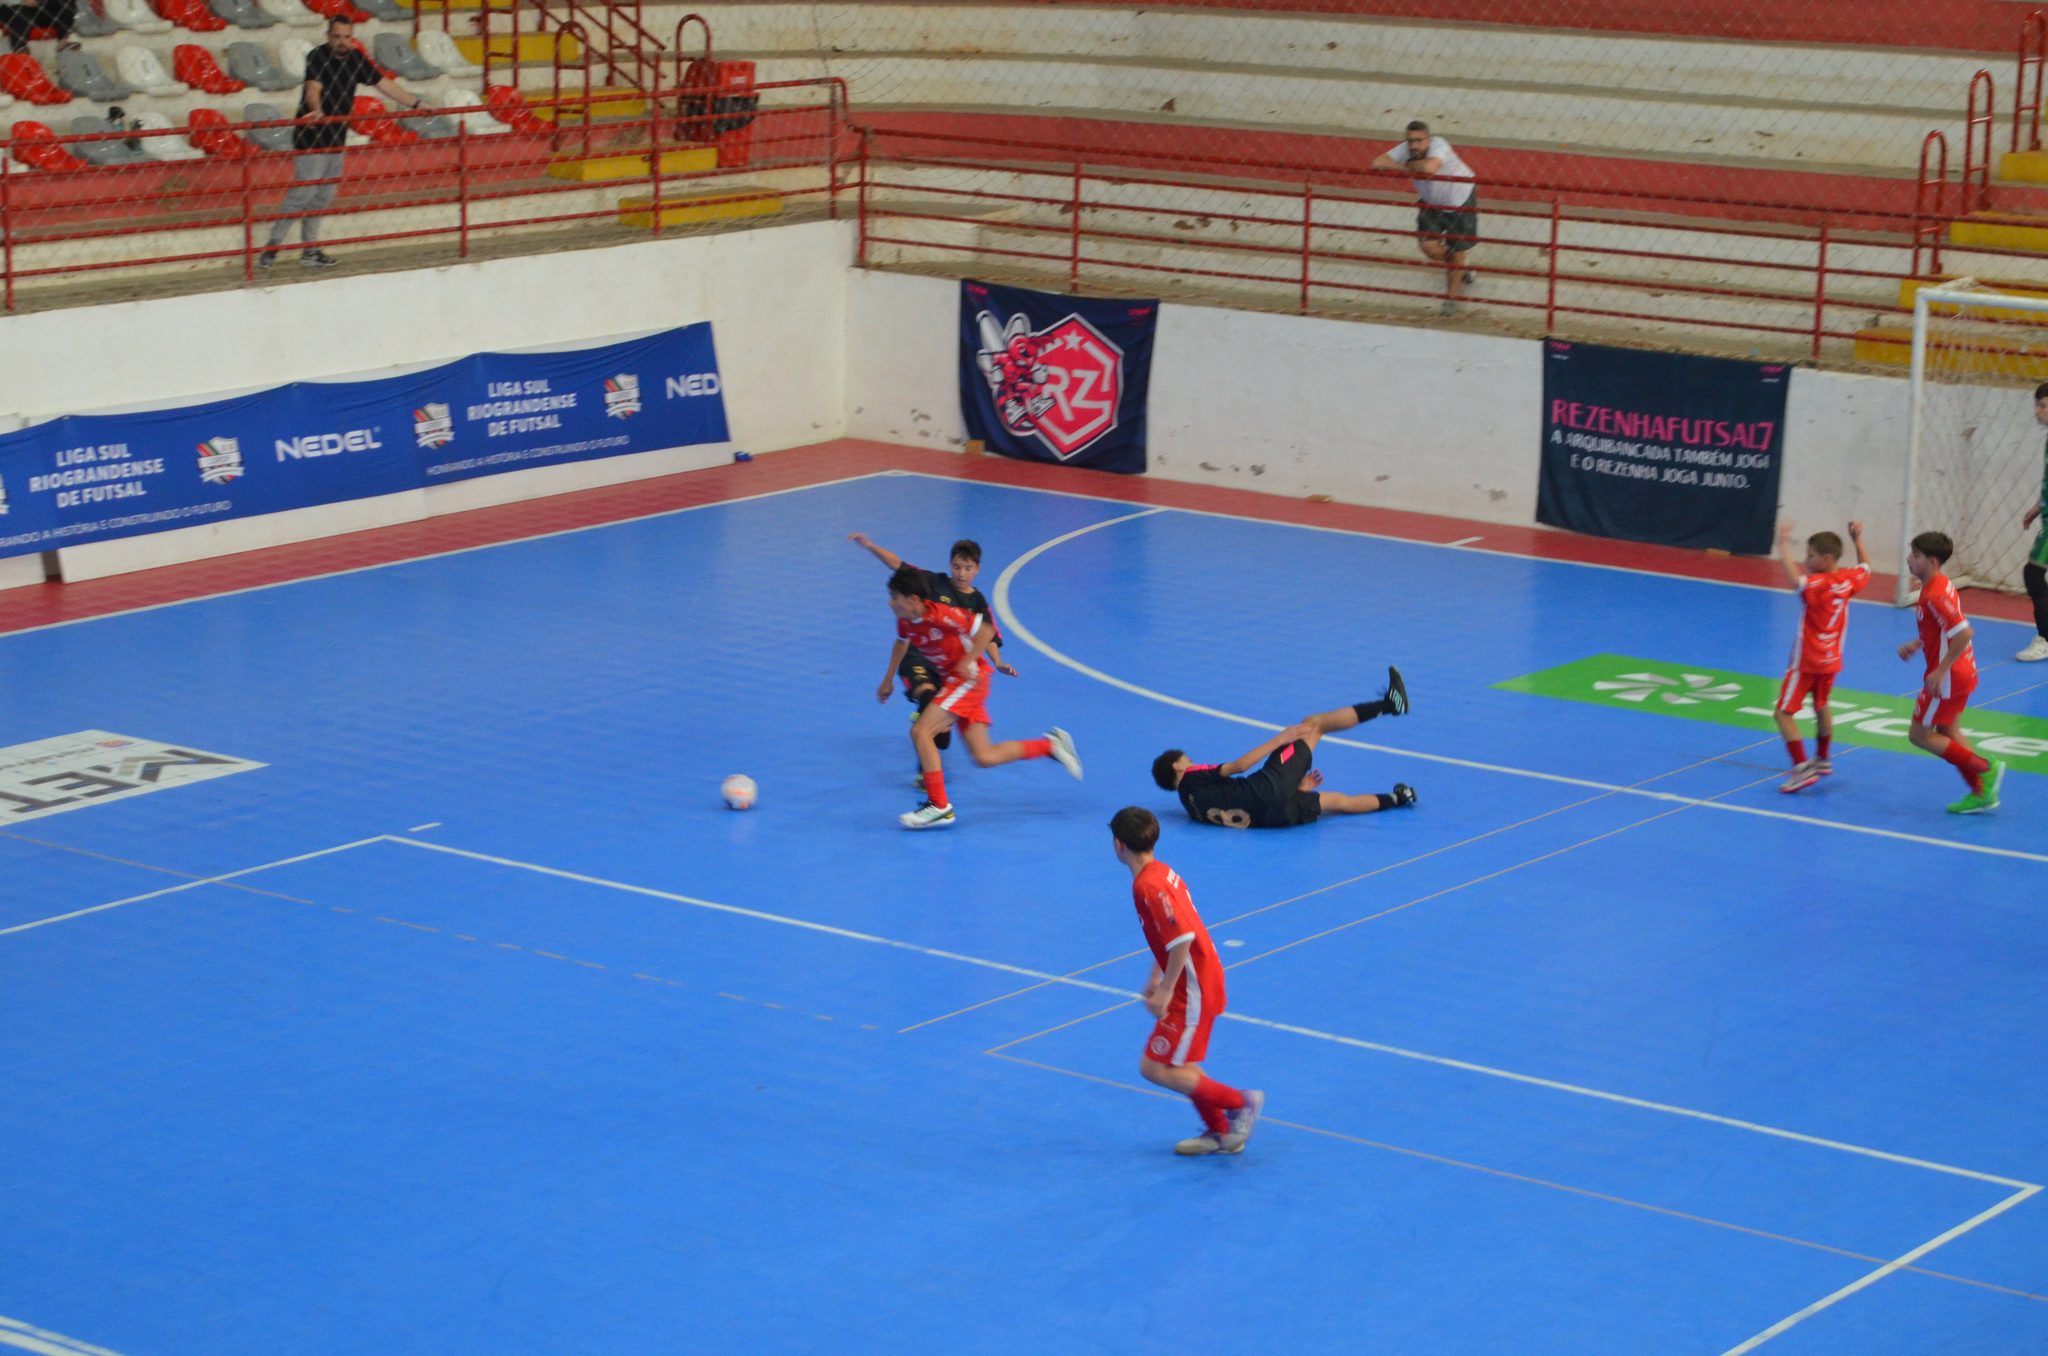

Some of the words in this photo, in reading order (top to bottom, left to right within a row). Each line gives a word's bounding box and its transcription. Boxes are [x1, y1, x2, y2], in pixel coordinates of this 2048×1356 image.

[487, 381, 522, 398] LIGA
[523, 379, 551, 394] SUL
[467, 393, 577, 421] RIOGRANDENSE
[488, 421, 508, 437] DE
[509, 414, 562, 434] FUTSAL
[56, 446, 97, 467] LIGA
[98, 443, 132, 460] SUL
[275, 429, 382, 462] NEDEL
[1550, 429, 1563, 444] A
[1734, 453, 1771, 469] JOGA
[29, 458, 165, 493] RIOGRANDENSE
[1581, 455, 1595, 471] O
[1661, 468, 1699, 485] JOGA
[56, 490, 81, 508] DE
[82, 481, 147, 504] FUTSAL
[1826, 598, 1844, 629] 7
